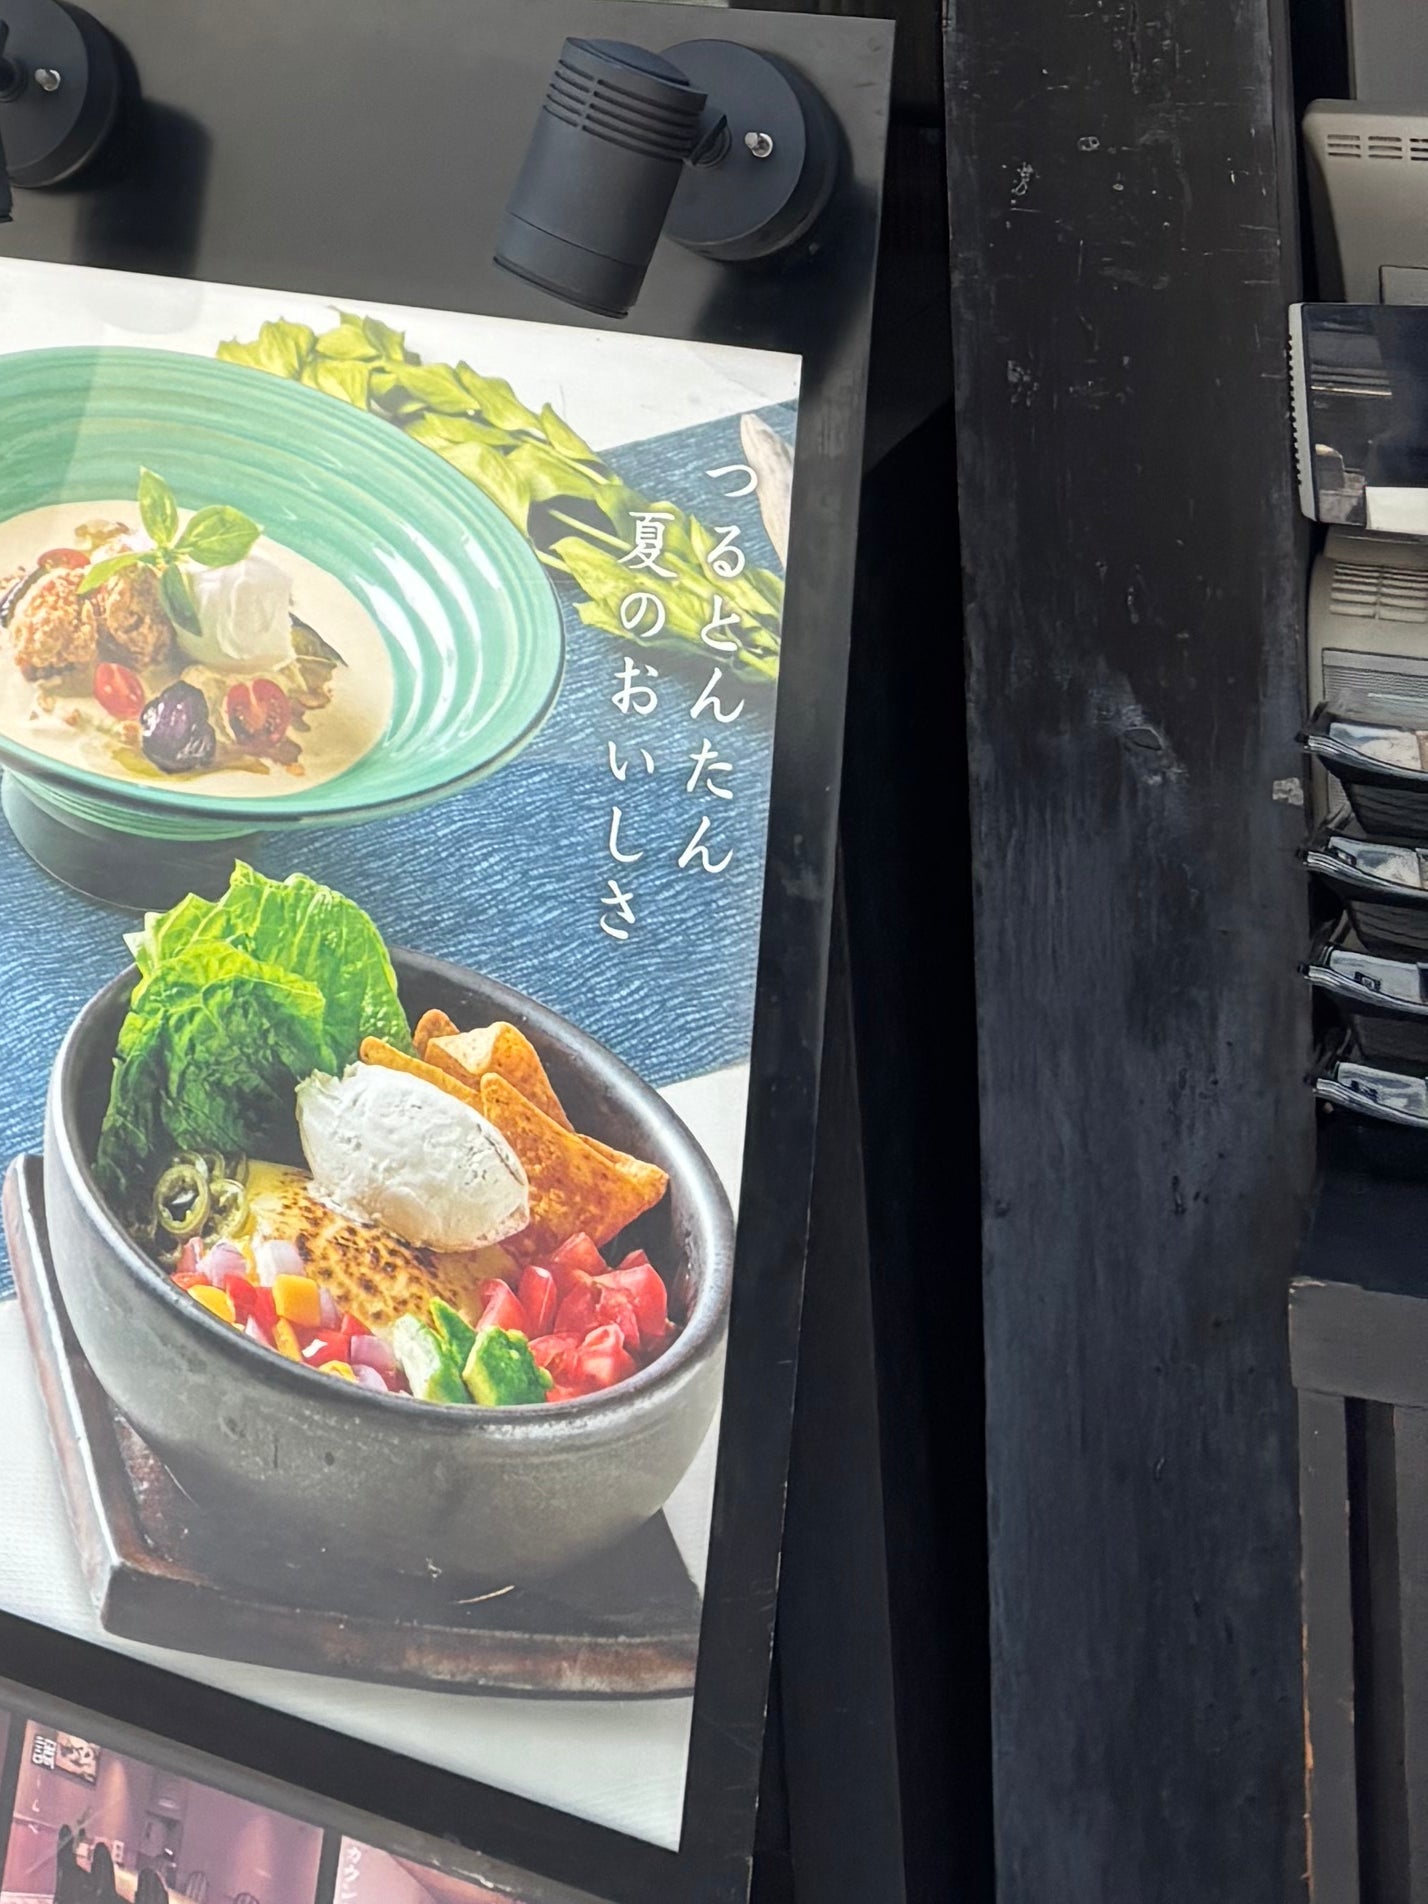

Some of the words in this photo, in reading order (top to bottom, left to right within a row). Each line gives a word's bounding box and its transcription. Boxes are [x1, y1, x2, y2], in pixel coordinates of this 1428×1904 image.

[599, 510, 679, 941] 夏のおいしさ
[677, 461, 759, 876] つるとんたん
